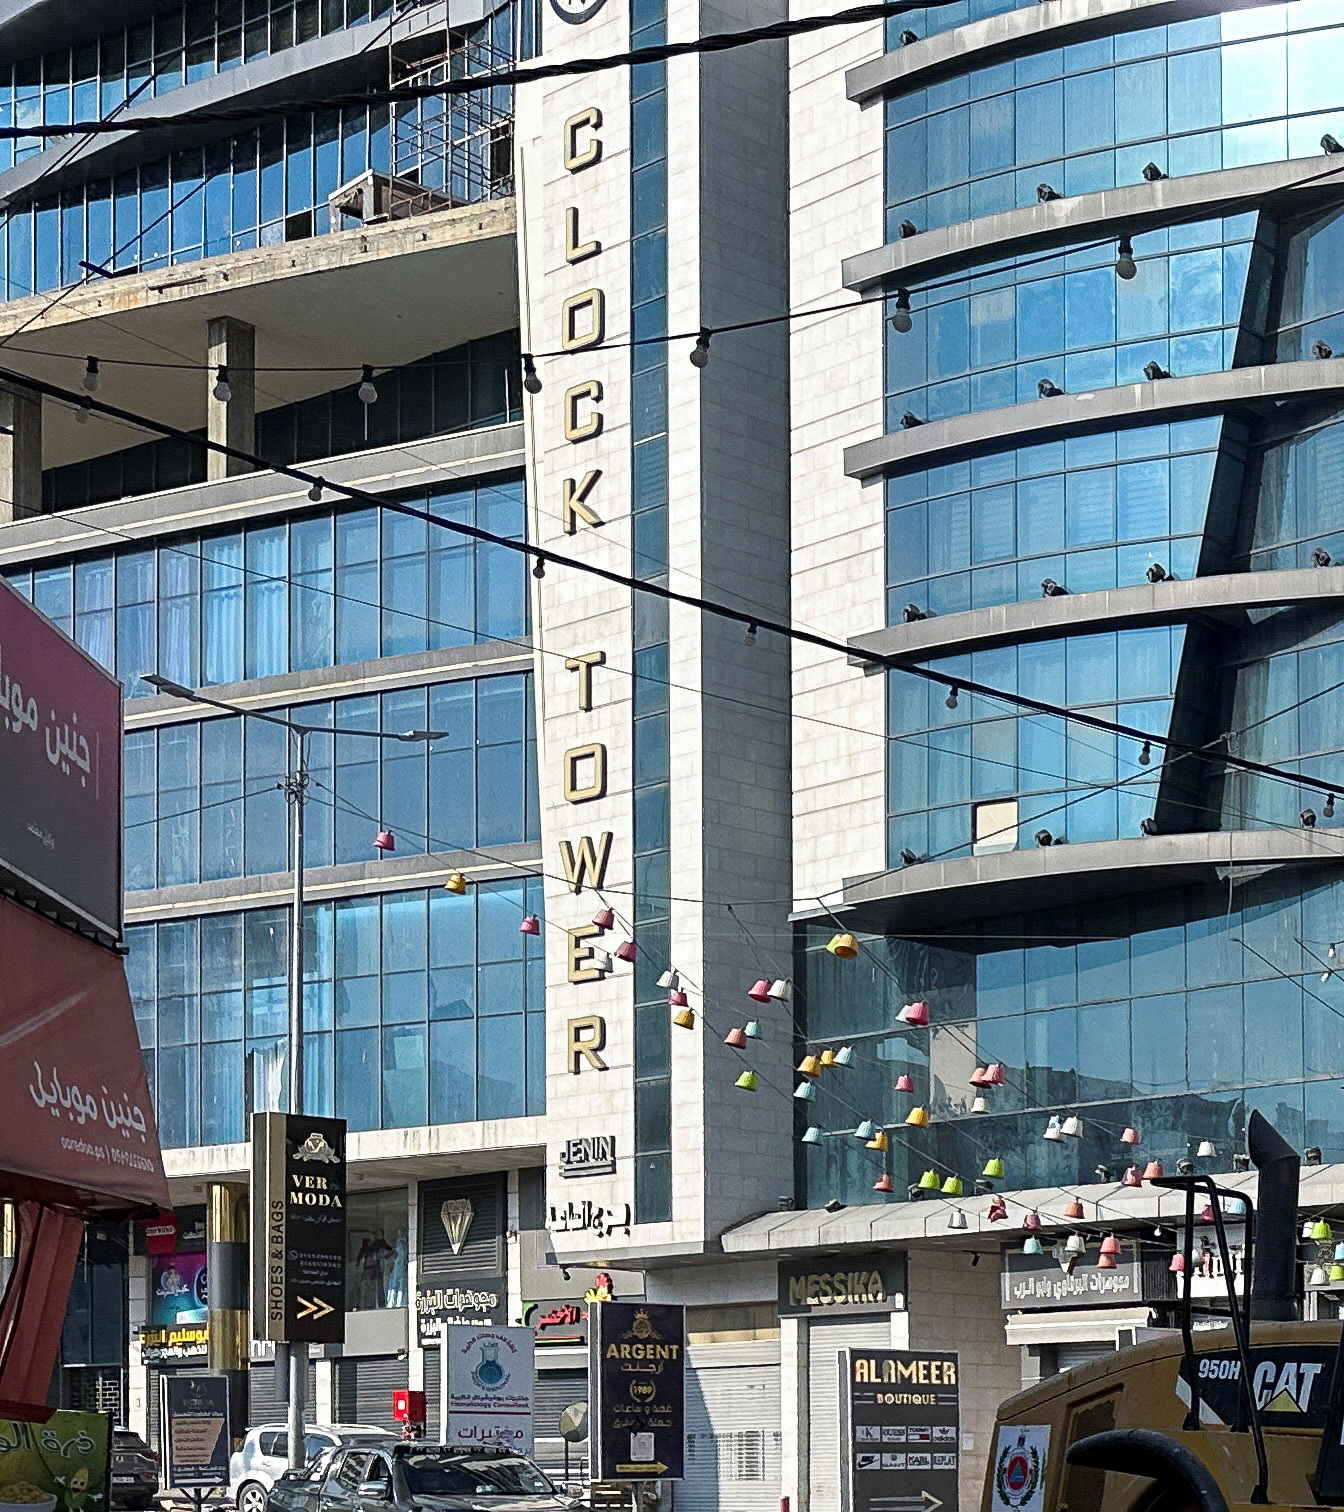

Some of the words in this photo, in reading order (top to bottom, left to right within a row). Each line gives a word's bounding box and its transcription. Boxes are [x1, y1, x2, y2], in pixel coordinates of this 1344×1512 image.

[563, 106, 605, 535] CLOCK
[45, 710, 90, 787] جنين
[559, 651, 613, 1075] TOWER
[29, 1061, 98, 1125] موبايل
[102, 1085, 147, 1143] جنين
[289, 1191, 343, 1208] MODA
[292, 1175, 328, 1190] VER
[271, 1200, 284, 1244] BAGS
[272, 1249, 283, 1259] &
[271, 1265, 284, 1321] SHOES
[789, 1270, 884, 1307] MESSIKA
[606, 1344, 679, 1360] ARGENT
[1199, 1359, 1242, 1380] 950H
[634, 1385, 652, 1395] 1989
[855, 1359, 956, 1385] ALAMEER
[1252, 1361, 1323, 1412] CAT
[876, 1393, 937, 1405] BOUTIQUE
